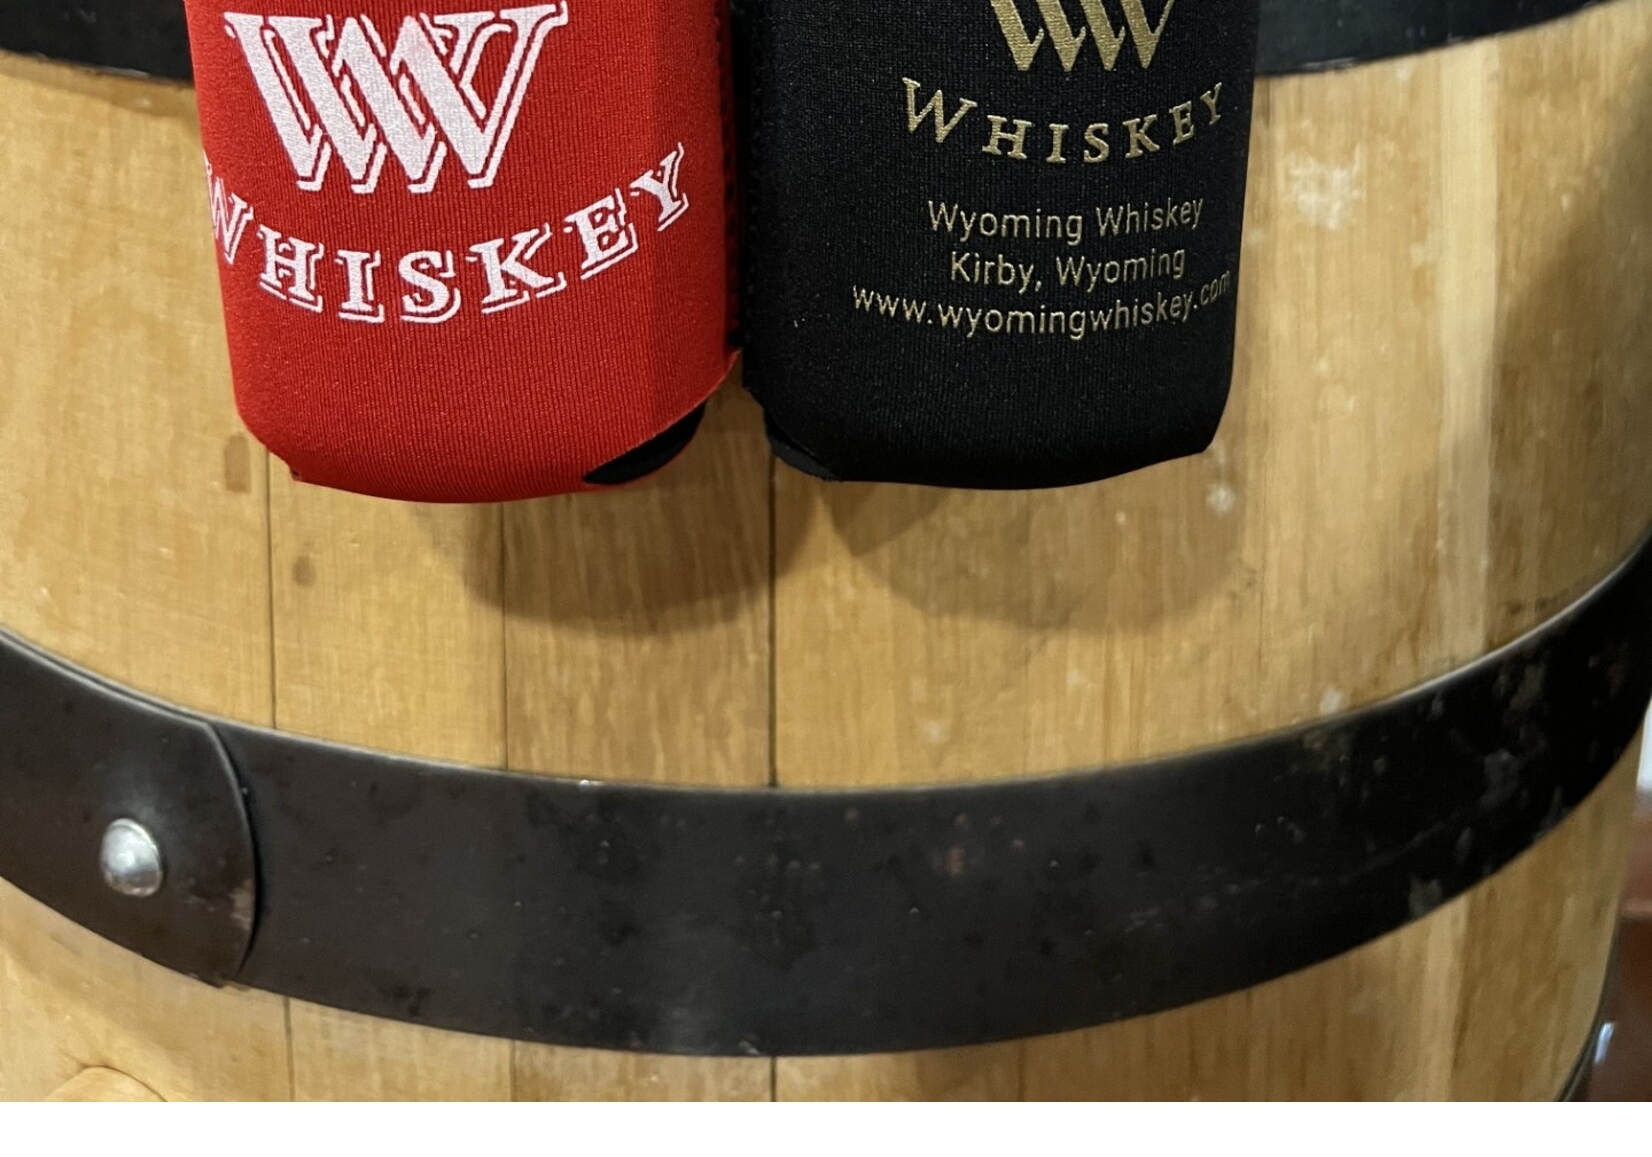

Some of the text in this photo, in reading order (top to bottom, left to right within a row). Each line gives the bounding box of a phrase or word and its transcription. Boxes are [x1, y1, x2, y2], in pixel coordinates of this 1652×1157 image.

[902, 77, 1222, 163] WHISKEY
[203, 142, 690, 324] WHISKEY
[928, 197, 1203, 245] Wyoming Whiskey
[853, 268, 1231, 340] www.wyomingwhiskey.com
[951, 248, 1186, 294] Kirby, Wyoming
